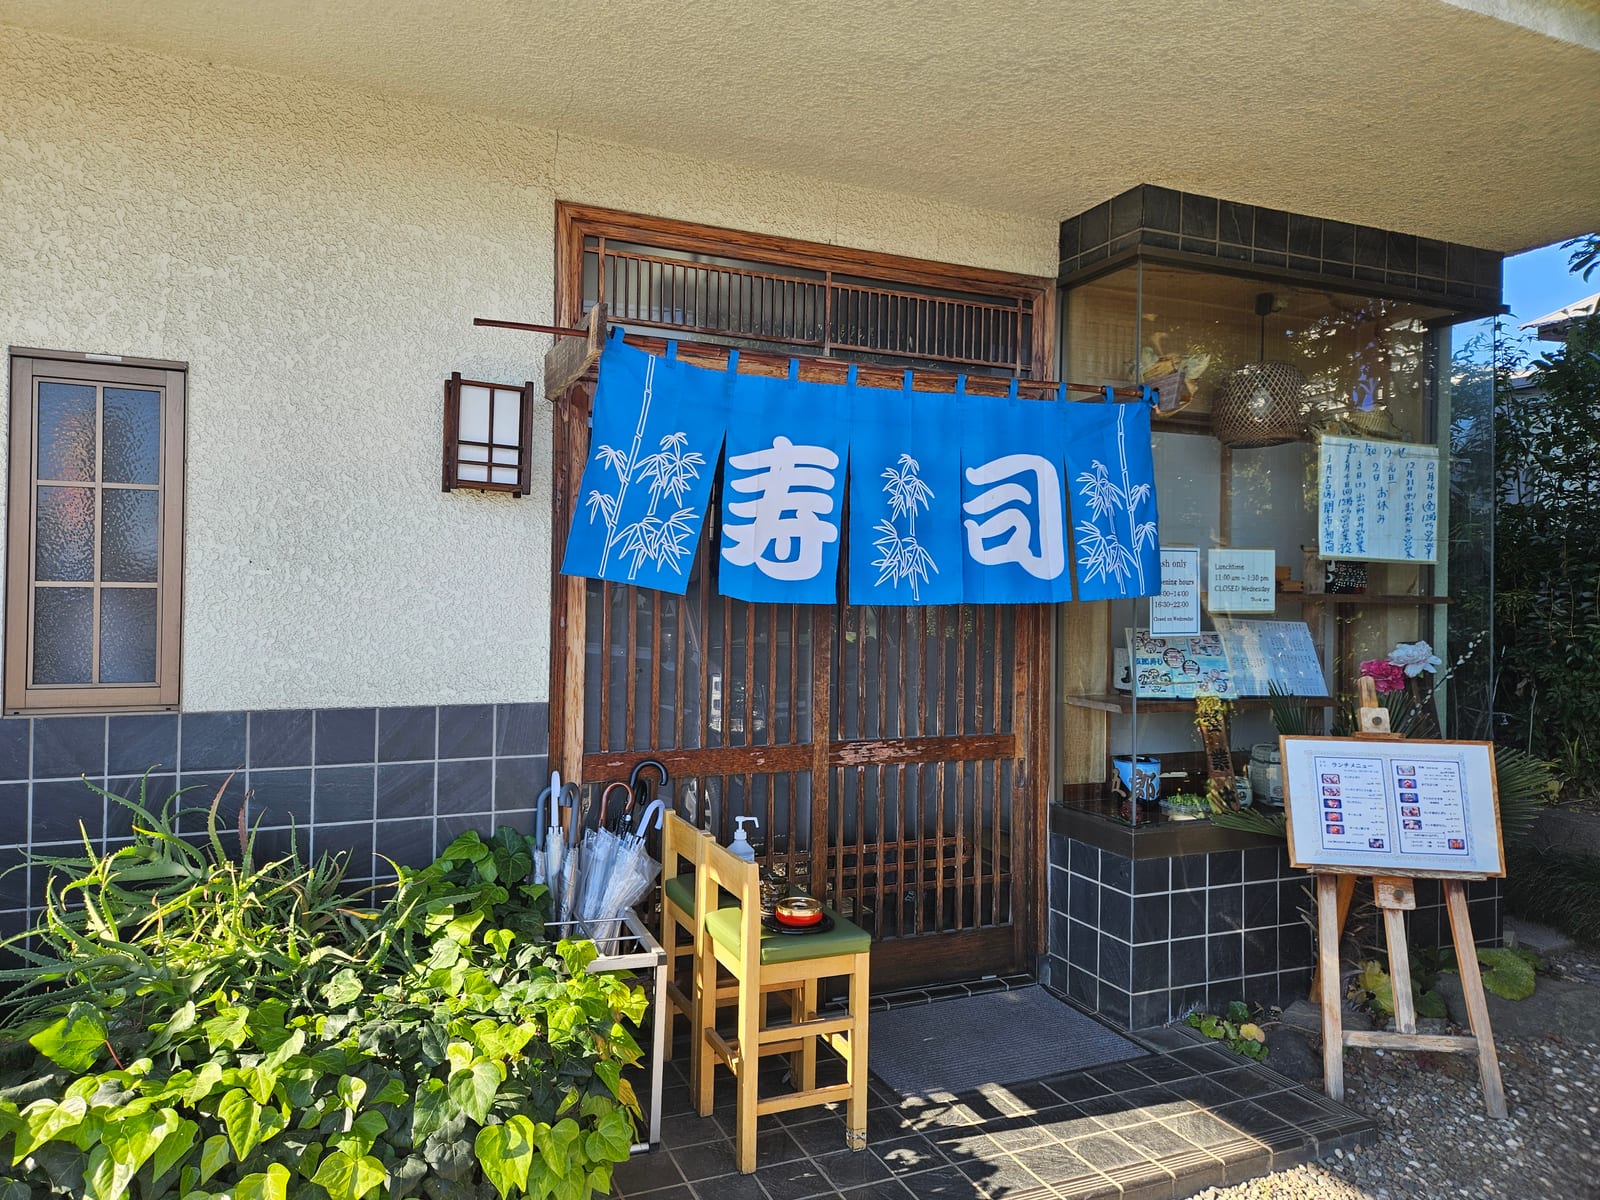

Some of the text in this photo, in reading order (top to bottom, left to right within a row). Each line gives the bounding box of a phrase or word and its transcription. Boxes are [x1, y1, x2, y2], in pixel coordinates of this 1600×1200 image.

[1161, 560, 1187, 569] sh only
[1214, 585, 1240, 593] CLOSED
